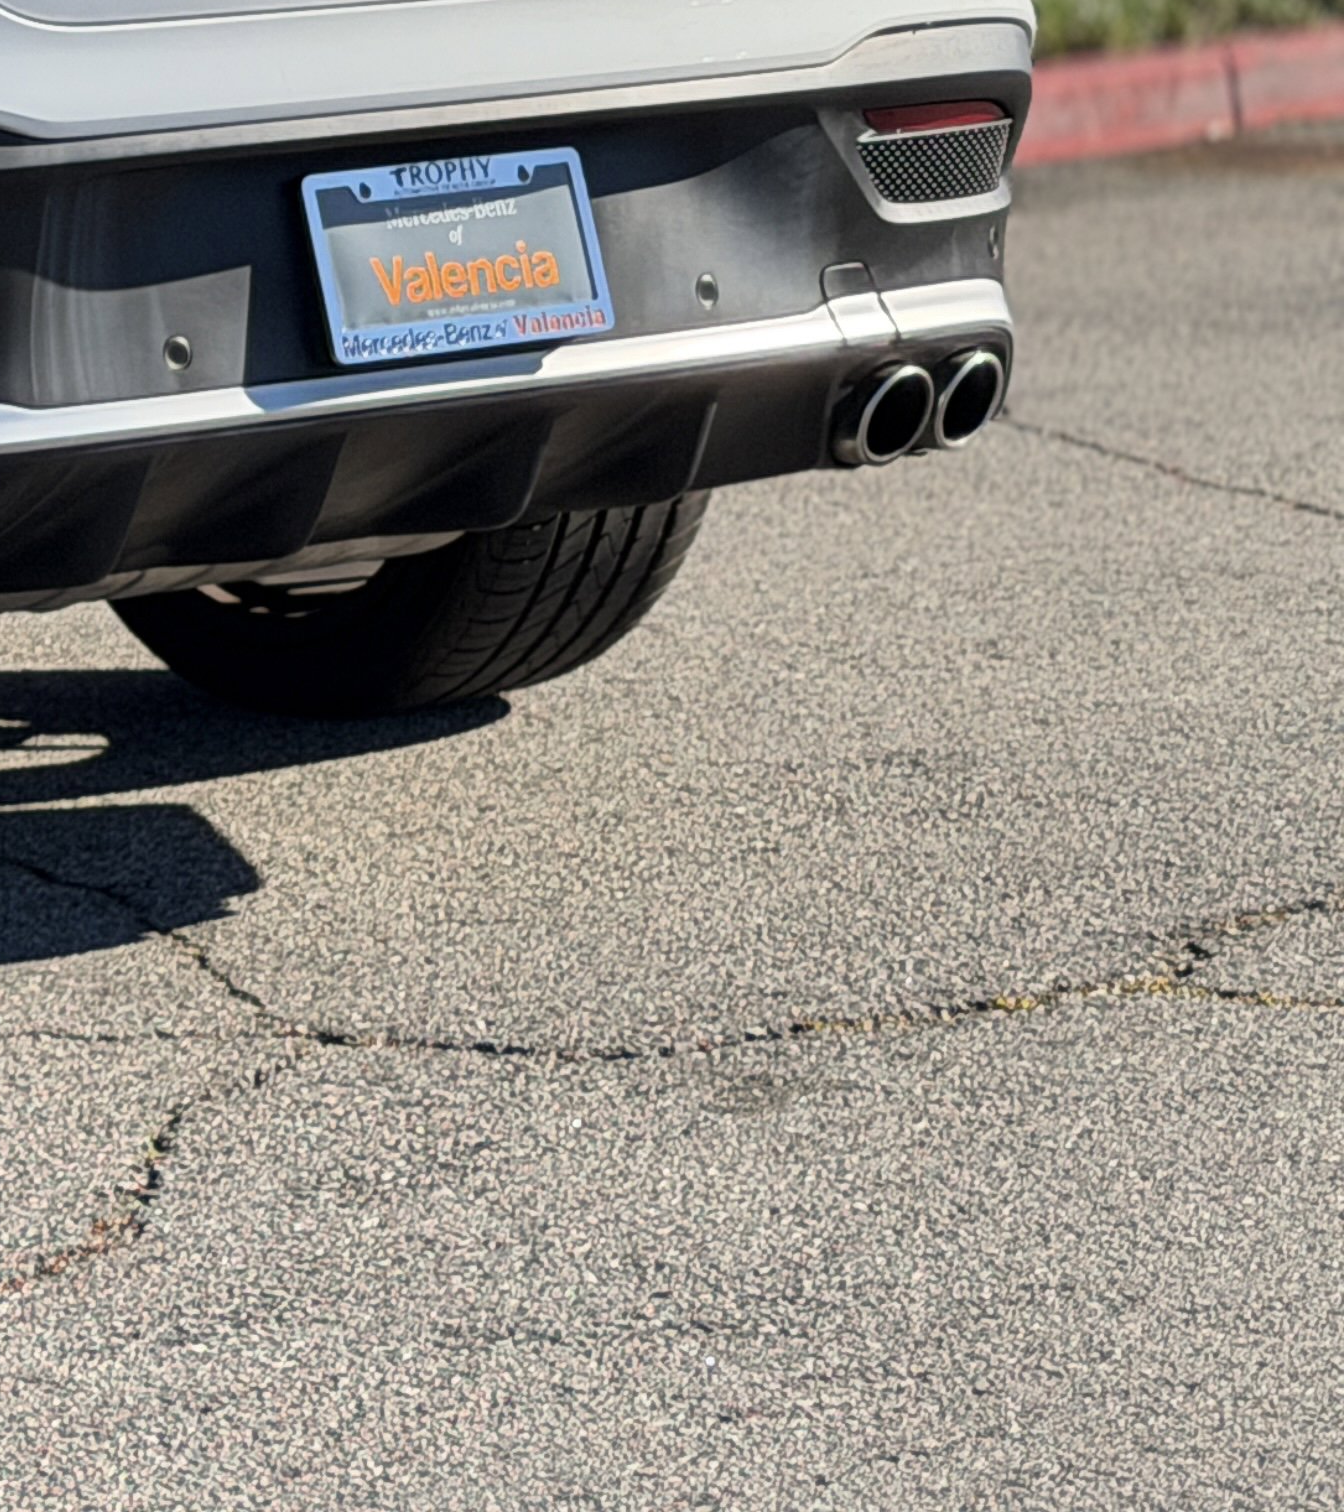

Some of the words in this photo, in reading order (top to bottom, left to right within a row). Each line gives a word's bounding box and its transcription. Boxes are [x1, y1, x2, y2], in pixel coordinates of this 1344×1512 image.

[389, 157, 491, 187] TROPHY
[448, 224, 464, 246] of
[370, 239, 561, 306] Valencia
[341, 322, 491, 359] Mercedes-Benz
[514, 305, 607, 335] Valencia
